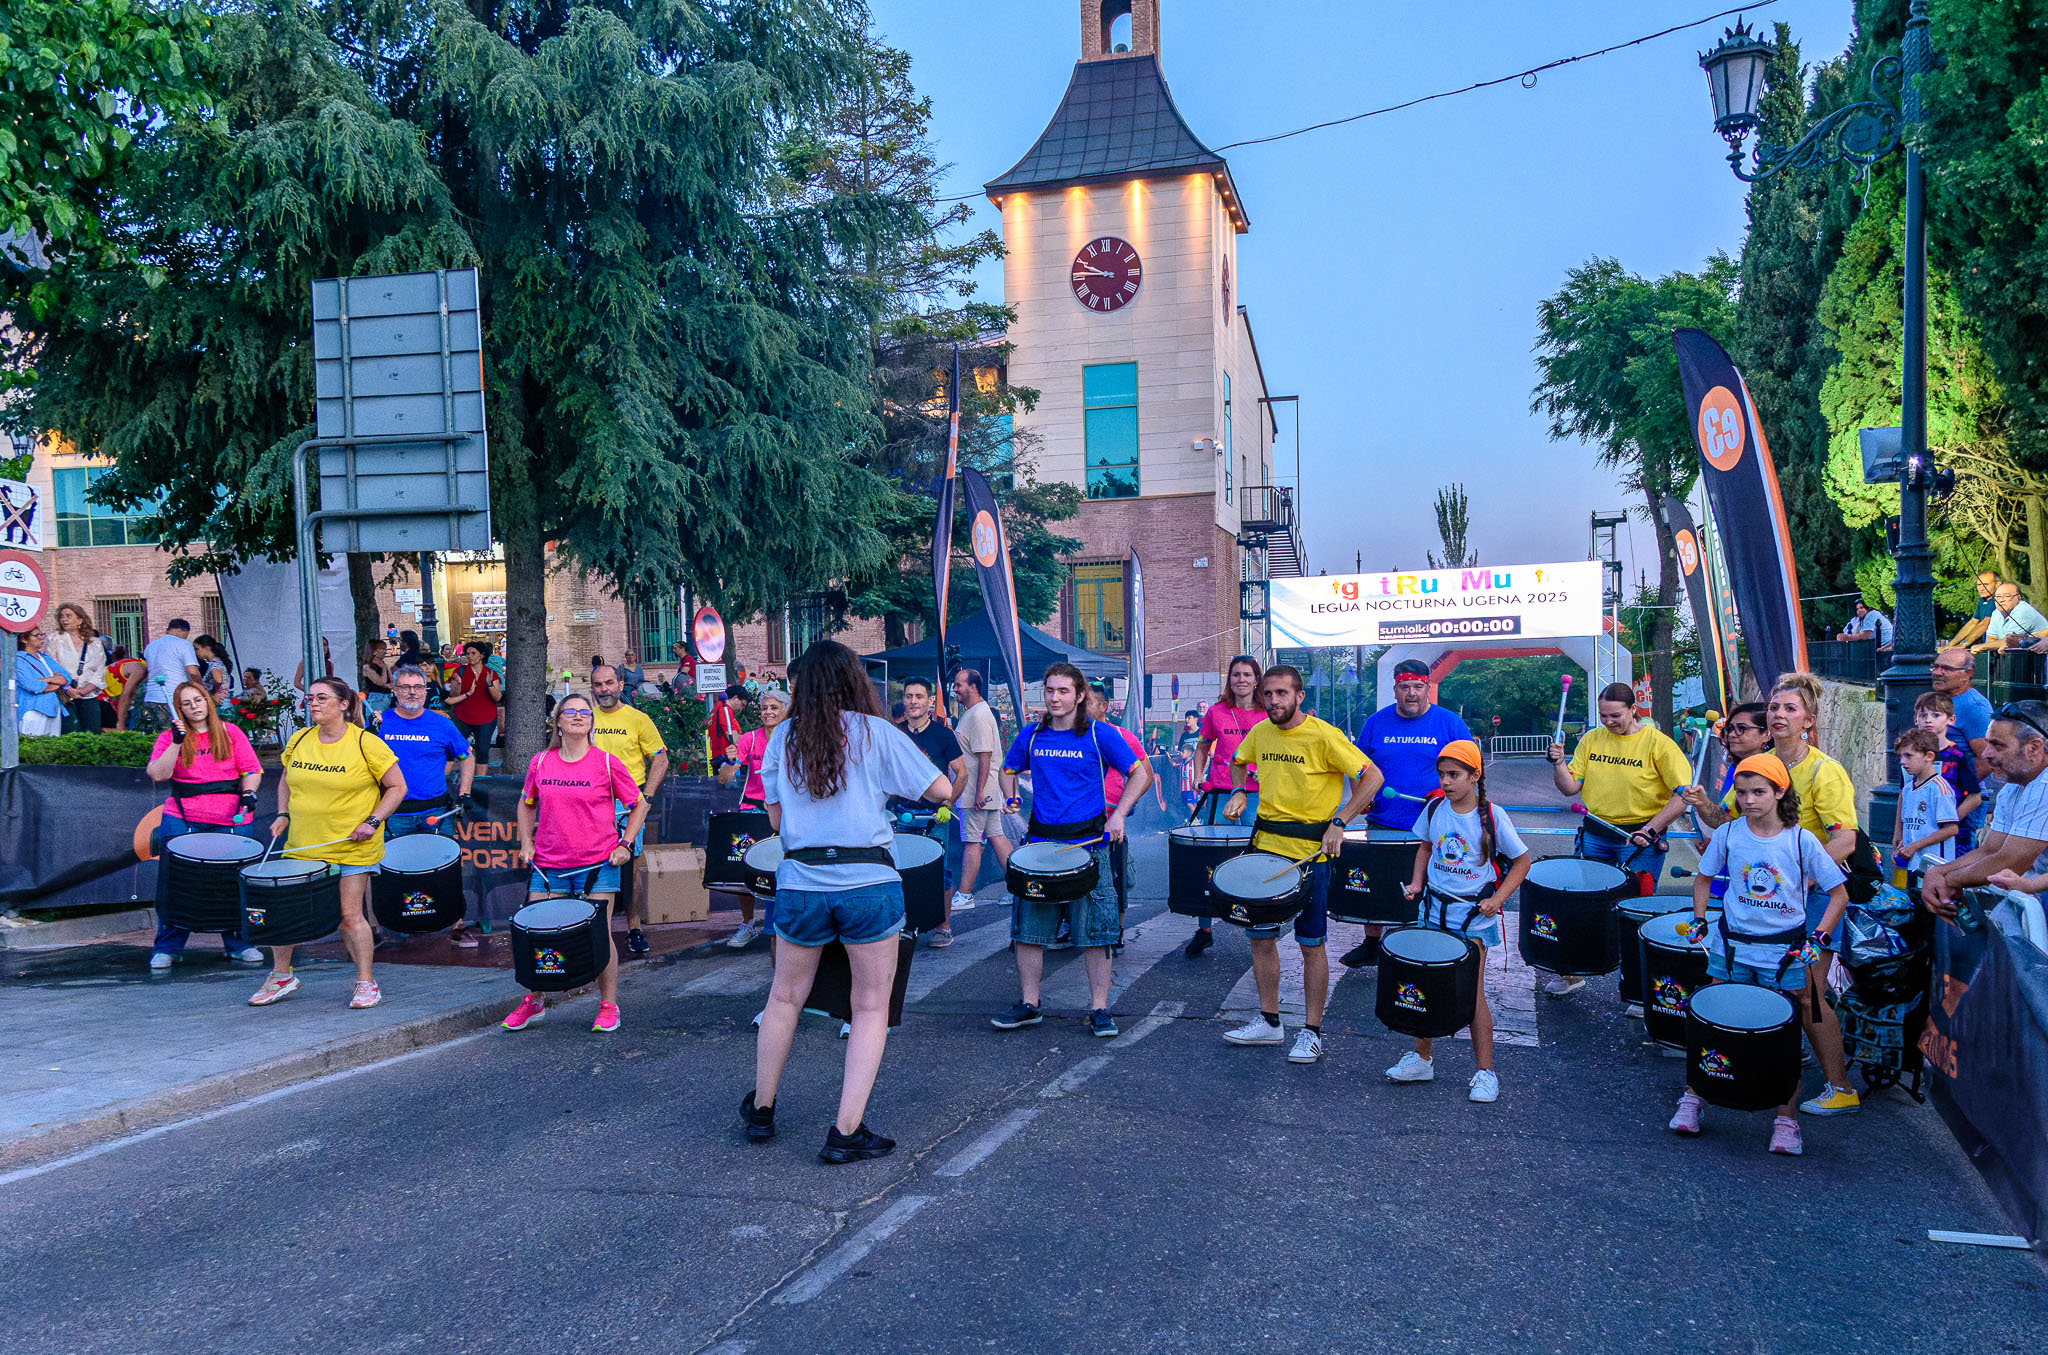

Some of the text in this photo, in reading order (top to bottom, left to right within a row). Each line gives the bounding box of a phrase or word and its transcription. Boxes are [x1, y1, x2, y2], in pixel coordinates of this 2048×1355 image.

[1086, 244, 1097, 258] XI
[1101, 239, 1111, 252] XII
[1123, 253, 1136, 263] II
[1128, 268, 1140, 276] III
[1103, 297, 1110, 310] VI
[1311, 591, 1568, 614] LEGUA NOCTURNA UGENA 2025
[1429, 619, 1514, 635] 00:00:00
[384, 733, 430, 742] BATUKAIKA
[594, 728, 627, 736] TUKAIKA
[1383, 736, 1438, 745] BATUKAIKA
[1034, 748, 1083, 759] BATUKAIKA
[1262, 753, 1305, 764] BATUKAIKA
[291, 760, 346, 773] BATUKAIKA
[1589, 753, 1643, 768] BATUKAIKA
[541, 778, 591, 787] BATUKAIKA
[461, 847, 528, 869] PORT
[1433, 862, 1472, 875] BATUKAIKA
[1738, 895, 1788, 910] BATUKAIKA
[1652, 1004, 1687, 1019] BATUKAI
